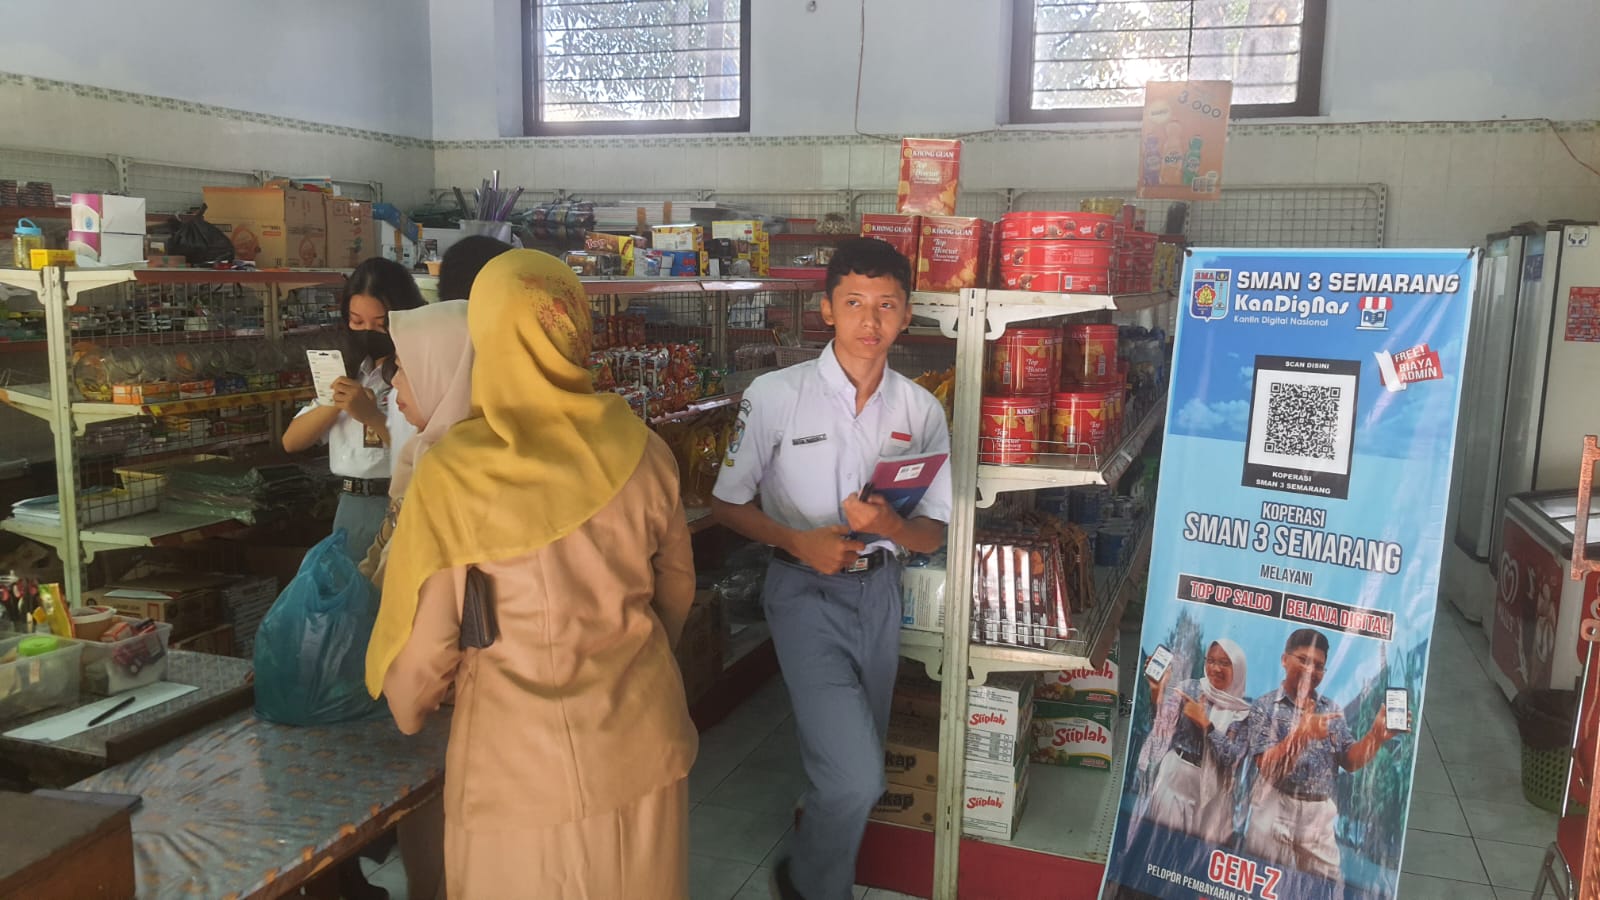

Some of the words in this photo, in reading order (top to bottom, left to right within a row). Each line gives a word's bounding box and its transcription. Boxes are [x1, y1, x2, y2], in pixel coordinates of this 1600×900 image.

[936, 151, 954, 159] GUAN
[894, 225, 912, 233] GUAN
[1236, 271, 1300, 291] SMAN
[1307, 273, 1322, 291] 3
[1328, 274, 1460, 294] SEMARANG
[1233, 315, 1260, 324] Kantin
[1261, 316, 1288, 326] Digital
[1290, 317, 1329, 327] Nasional
[1395, 345, 1426, 363] FREE!
[1399, 357, 1433, 373] BIAYA
[1400, 367, 1438, 382] ADMIN
[1256, 479, 1278, 488] SMAN
[1286, 481, 1331, 494] SEMARANG
[1272, 471, 1312, 482] KOPERASI
[1261, 501, 1327, 528] KOPERASI
[1183, 511, 1249, 549] SMAN
[1252, 522, 1270, 552] 3
[1273, 526, 1402, 574] SEMARANG
[1260, 564, 1313, 586] MELAYANI
[1190, 580, 1215, 600] TOP
[1215, 586, 1232, 603] UP
[1233, 588, 1272, 612] SALDO
[1286, 599, 1338, 626] BELANJA
[1339, 607, 1389, 634] DIGITAL
[1147, 864, 1182, 884] PELOPOR
[1183, 876, 1236, 900] PEMBAYARAN
[1208, 849, 1282, 900] GEN-Z
